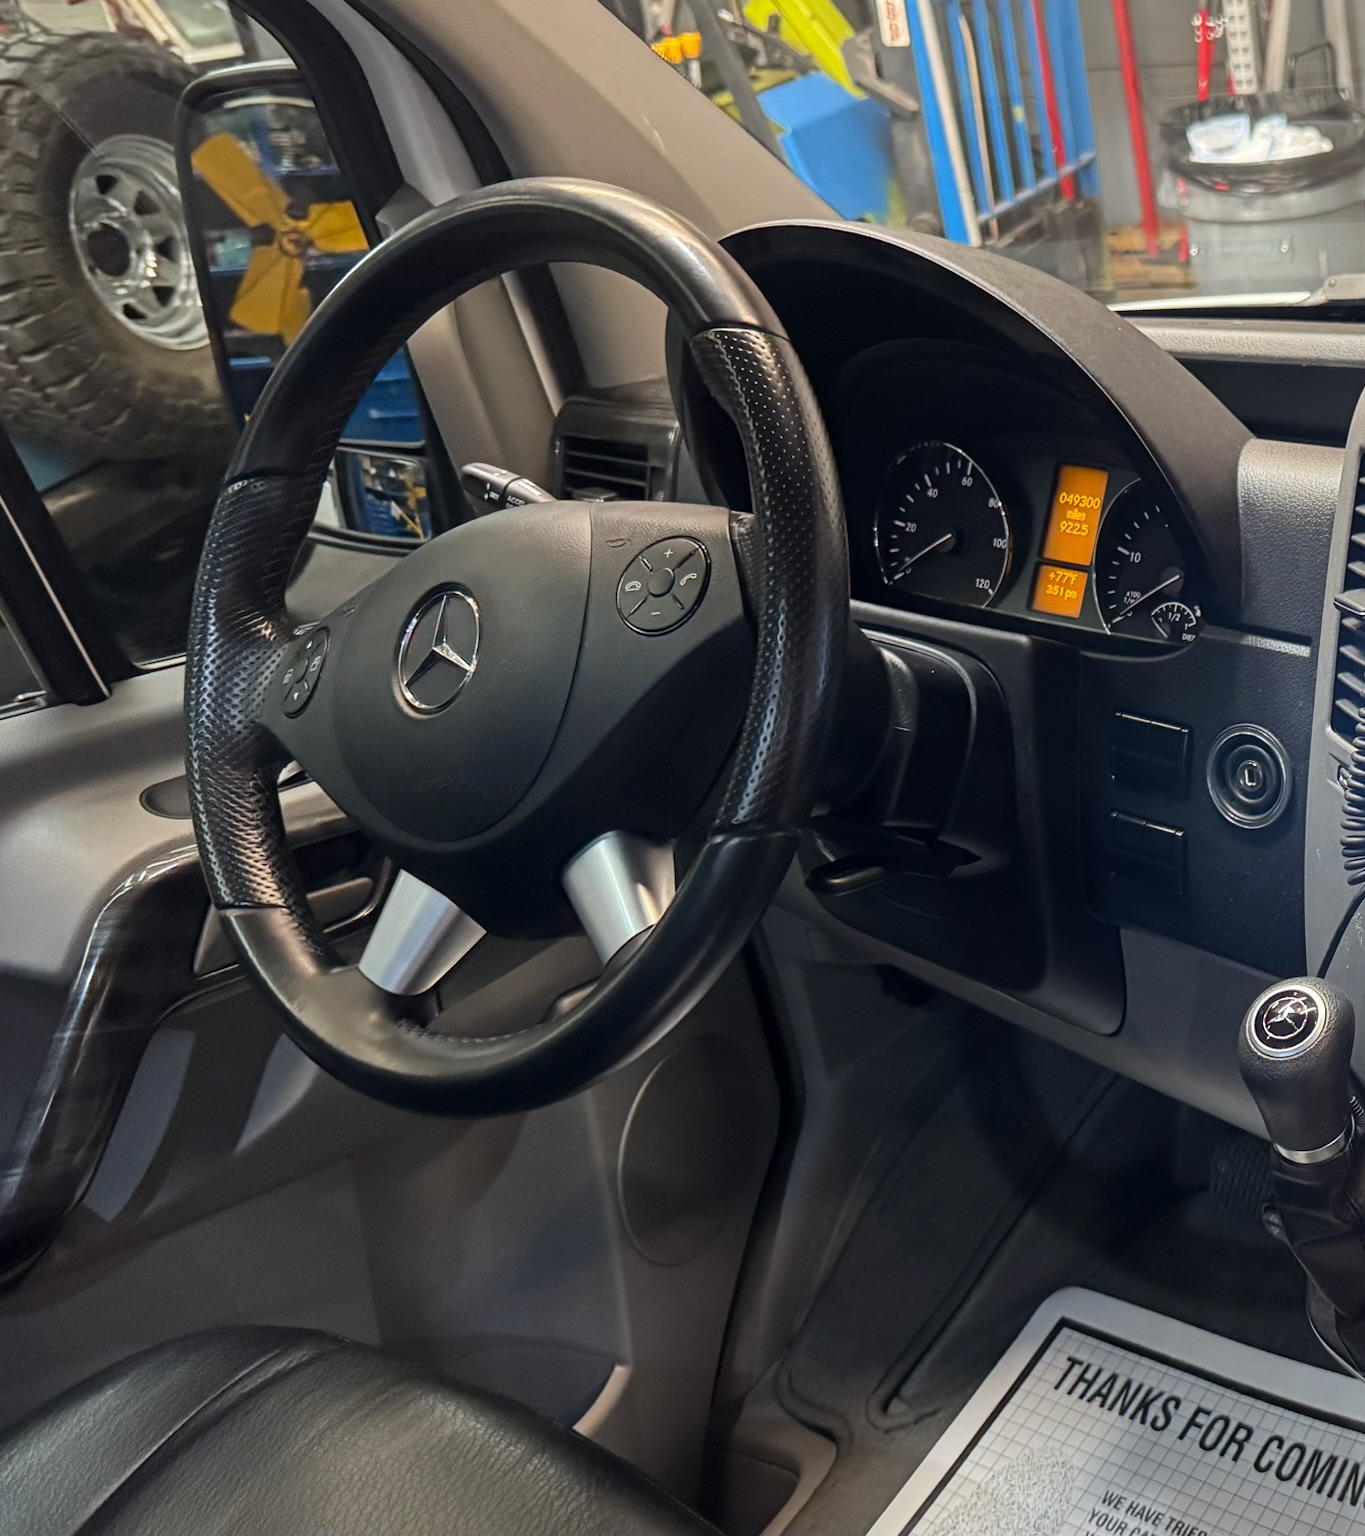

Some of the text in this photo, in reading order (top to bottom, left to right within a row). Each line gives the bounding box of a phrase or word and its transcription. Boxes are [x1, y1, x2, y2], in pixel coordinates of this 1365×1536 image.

[962, 477, 973, 487] 60
[927, 488, 938, 498] 40
[988, 498, 1001, 508] 80
[1059, 492, 1101, 509] 049300
[1066, 508, 1087, 522] miles
[905, 523, 917, 533] 20
[1059, 520, 1089, 536] 922.5
[993, 538, 1007, 549] 100
[1130, 551, 1142, 563] 10
[976, 578, 990, 589] 120
[1046, 584, 1077, 600] 3:51 pm
[1168, 612, 1181, 622] 1/2
[1053, 1356, 1181, 1432] THANKS
[1178, 1406, 1254, 1463] FOR
[1102, 1490, 1127, 1510] WE
[1125, 1500, 1165, 1527] HAVE
[1088, 1508, 1128, 1536] YOUR
